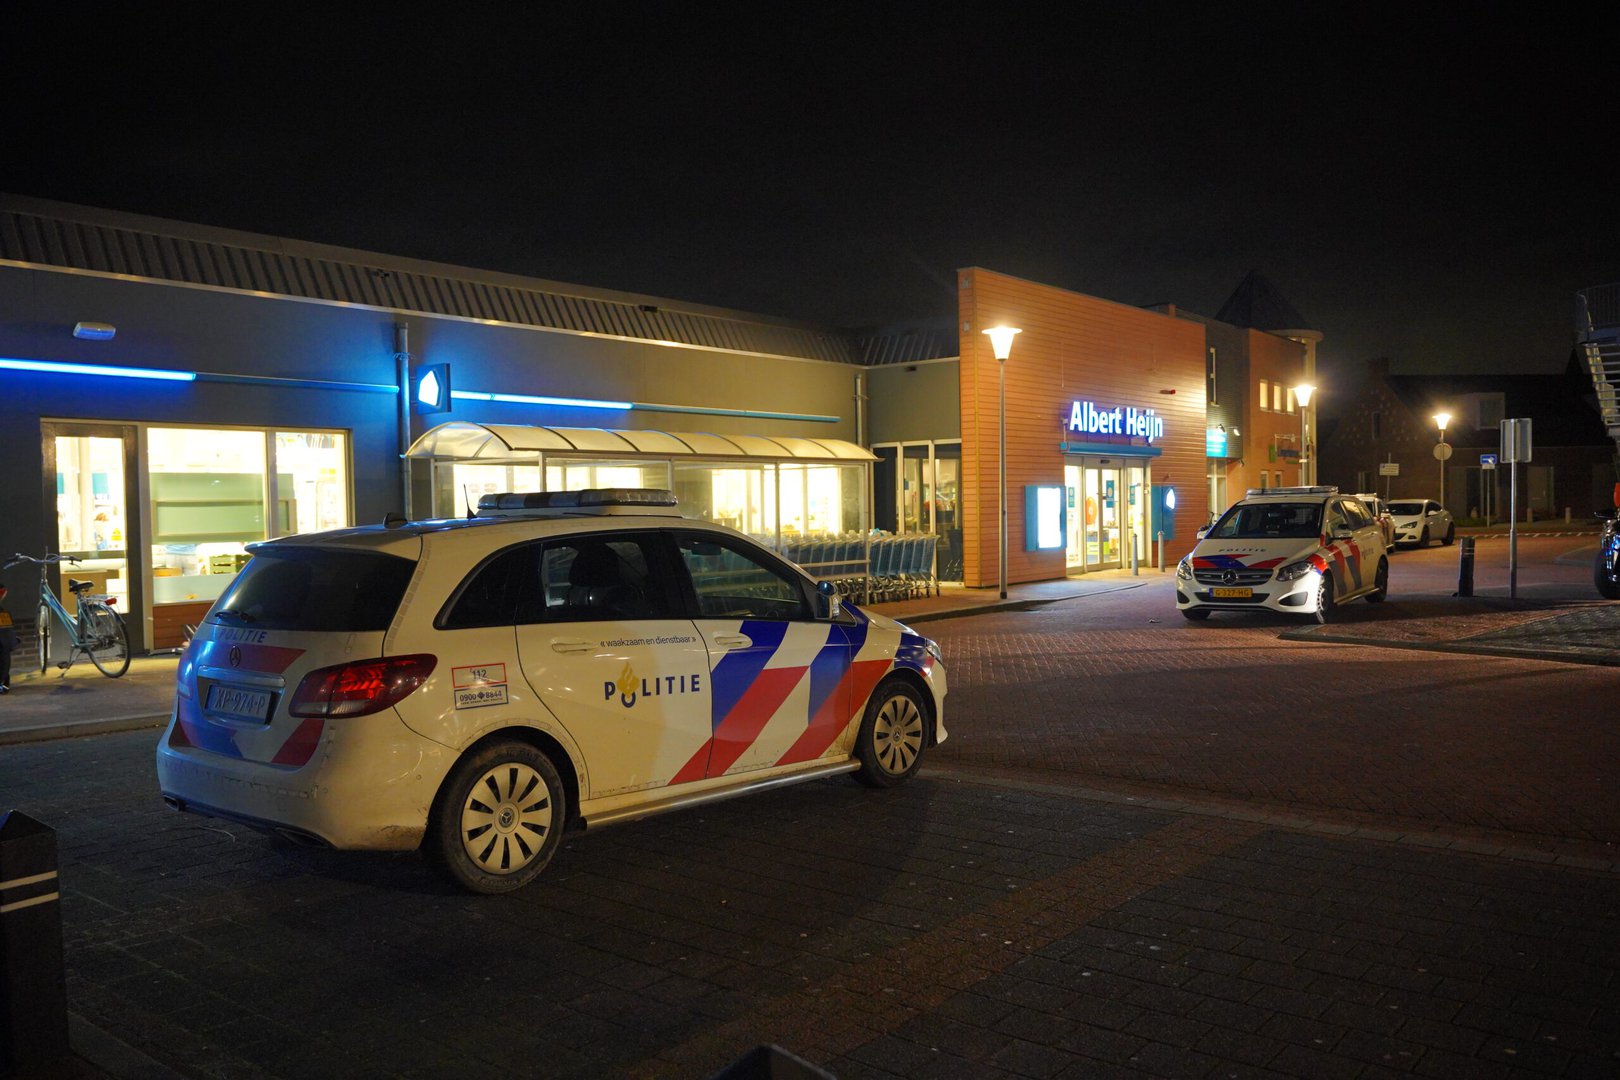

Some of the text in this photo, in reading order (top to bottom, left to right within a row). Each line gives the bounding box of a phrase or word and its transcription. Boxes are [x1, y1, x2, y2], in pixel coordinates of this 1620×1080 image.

[1070, 401, 1164, 442] Albert Heijn
[219, 628, 268, 643] POLITIE
[606, 638, 645, 647] waakzaam
[655, 636, 691, 645] dienstbaar
[472, 669, 488, 680] 112
[459, 693, 477, 702] 0900
[485, 690, 502, 699] 8844
